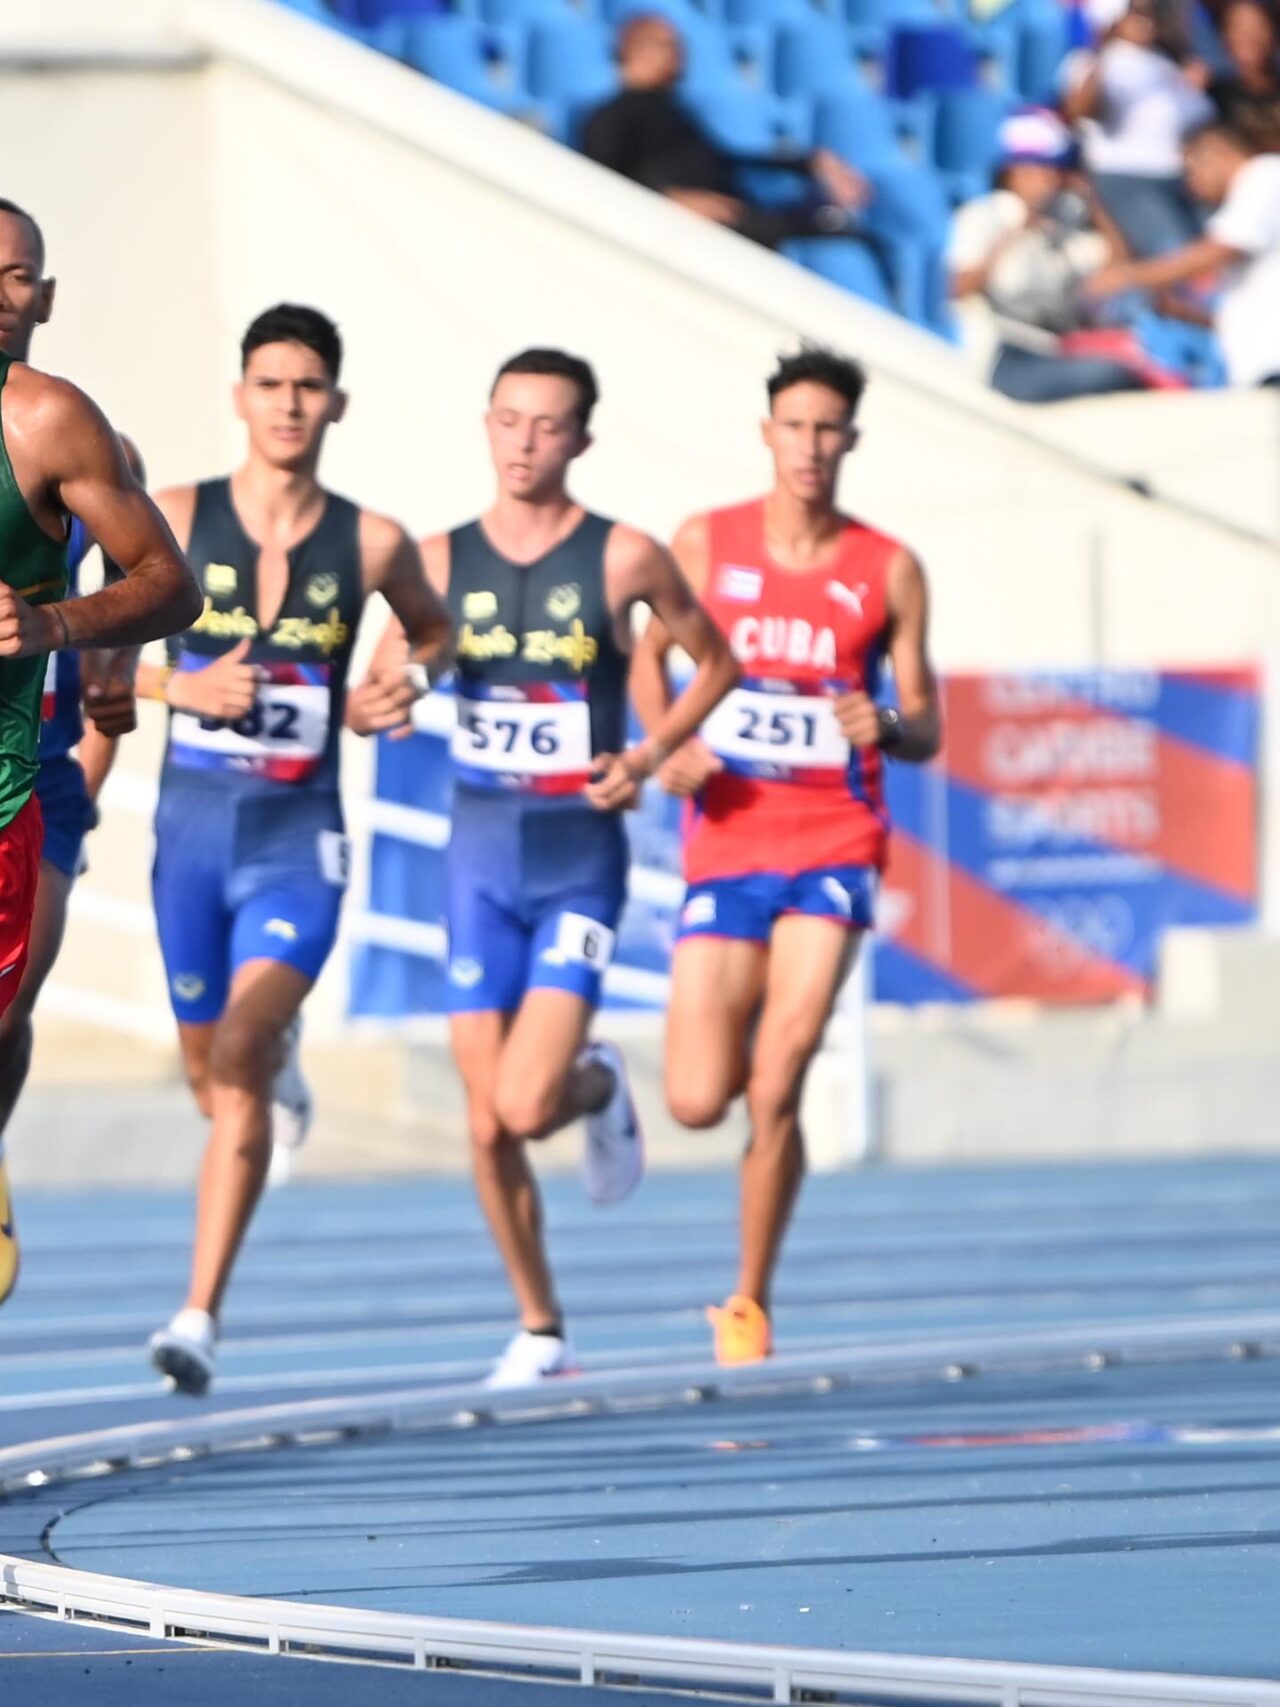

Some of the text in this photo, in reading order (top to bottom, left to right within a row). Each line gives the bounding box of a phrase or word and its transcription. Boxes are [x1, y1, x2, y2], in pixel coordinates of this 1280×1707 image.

[729, 616, 837, 672] CUBA
[469, 714, 559, 756] 576
[736, 705, 816, 747] 251
[583, 928, 600, 959] 6
